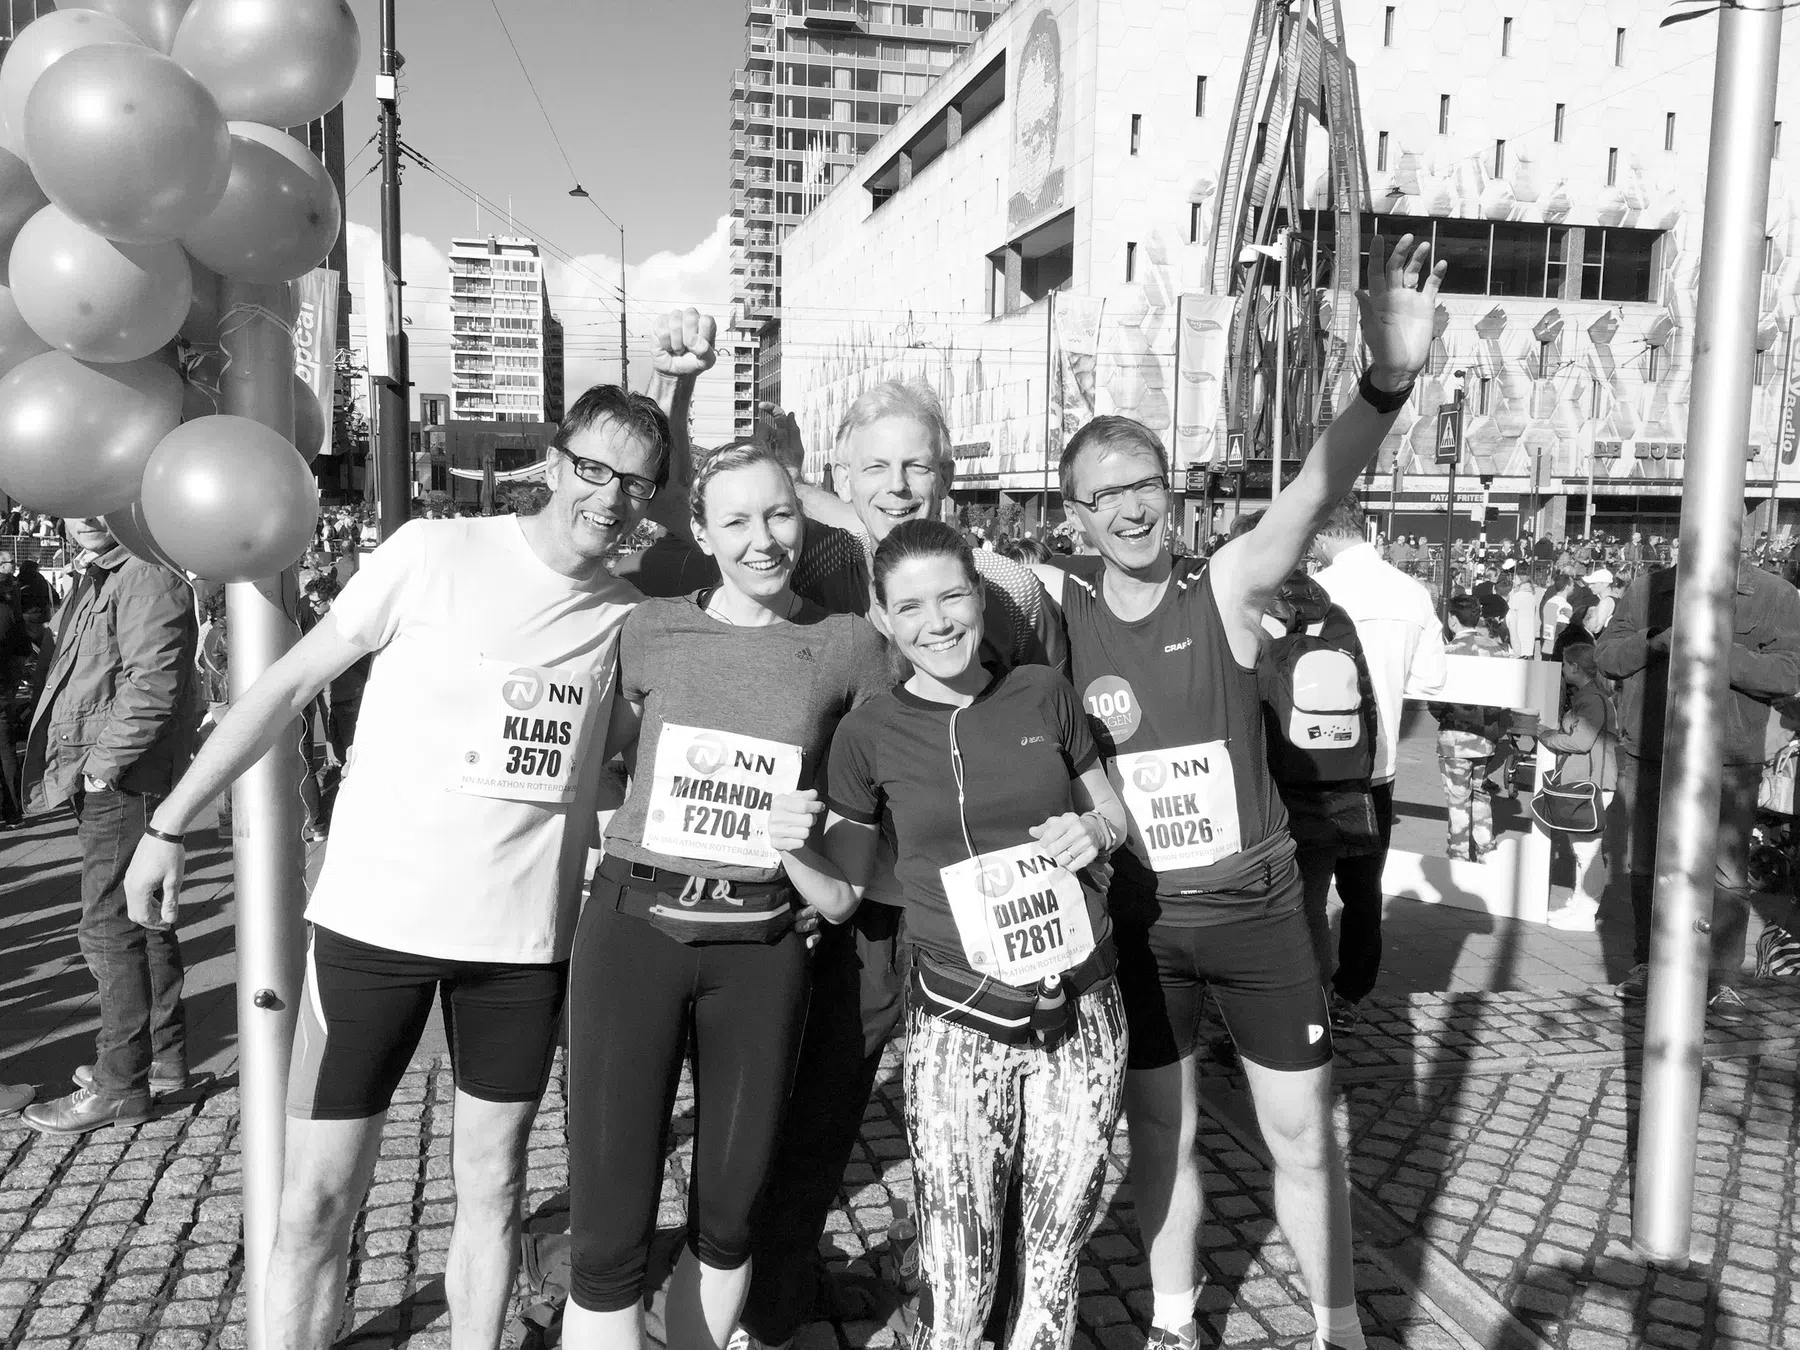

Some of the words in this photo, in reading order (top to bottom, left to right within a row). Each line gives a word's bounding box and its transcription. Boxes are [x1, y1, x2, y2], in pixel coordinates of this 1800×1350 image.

[1430, 493, 1456, 502] PATA
[549, 683, 583, 705] NN
[1088, 690, 1131, 718] 100
[503, 715, 572, 745] KLAAS
[506, 745, 562, 777] 3570
[734, 750, 776, 775] NN
[1171, 757, 1210, 779] NN
[670, 775, 773, 811] MIRANDA
[1150, 793, 1200, 819] NIEK
[682, 804, 751, 840] F2704
[1145, 818, 1214, 850] 10026
[1016, 854, 1058, 878] NN
[992, 888, 1060, 929] DIANA
[1003, 917, 1064, 962] F2817
